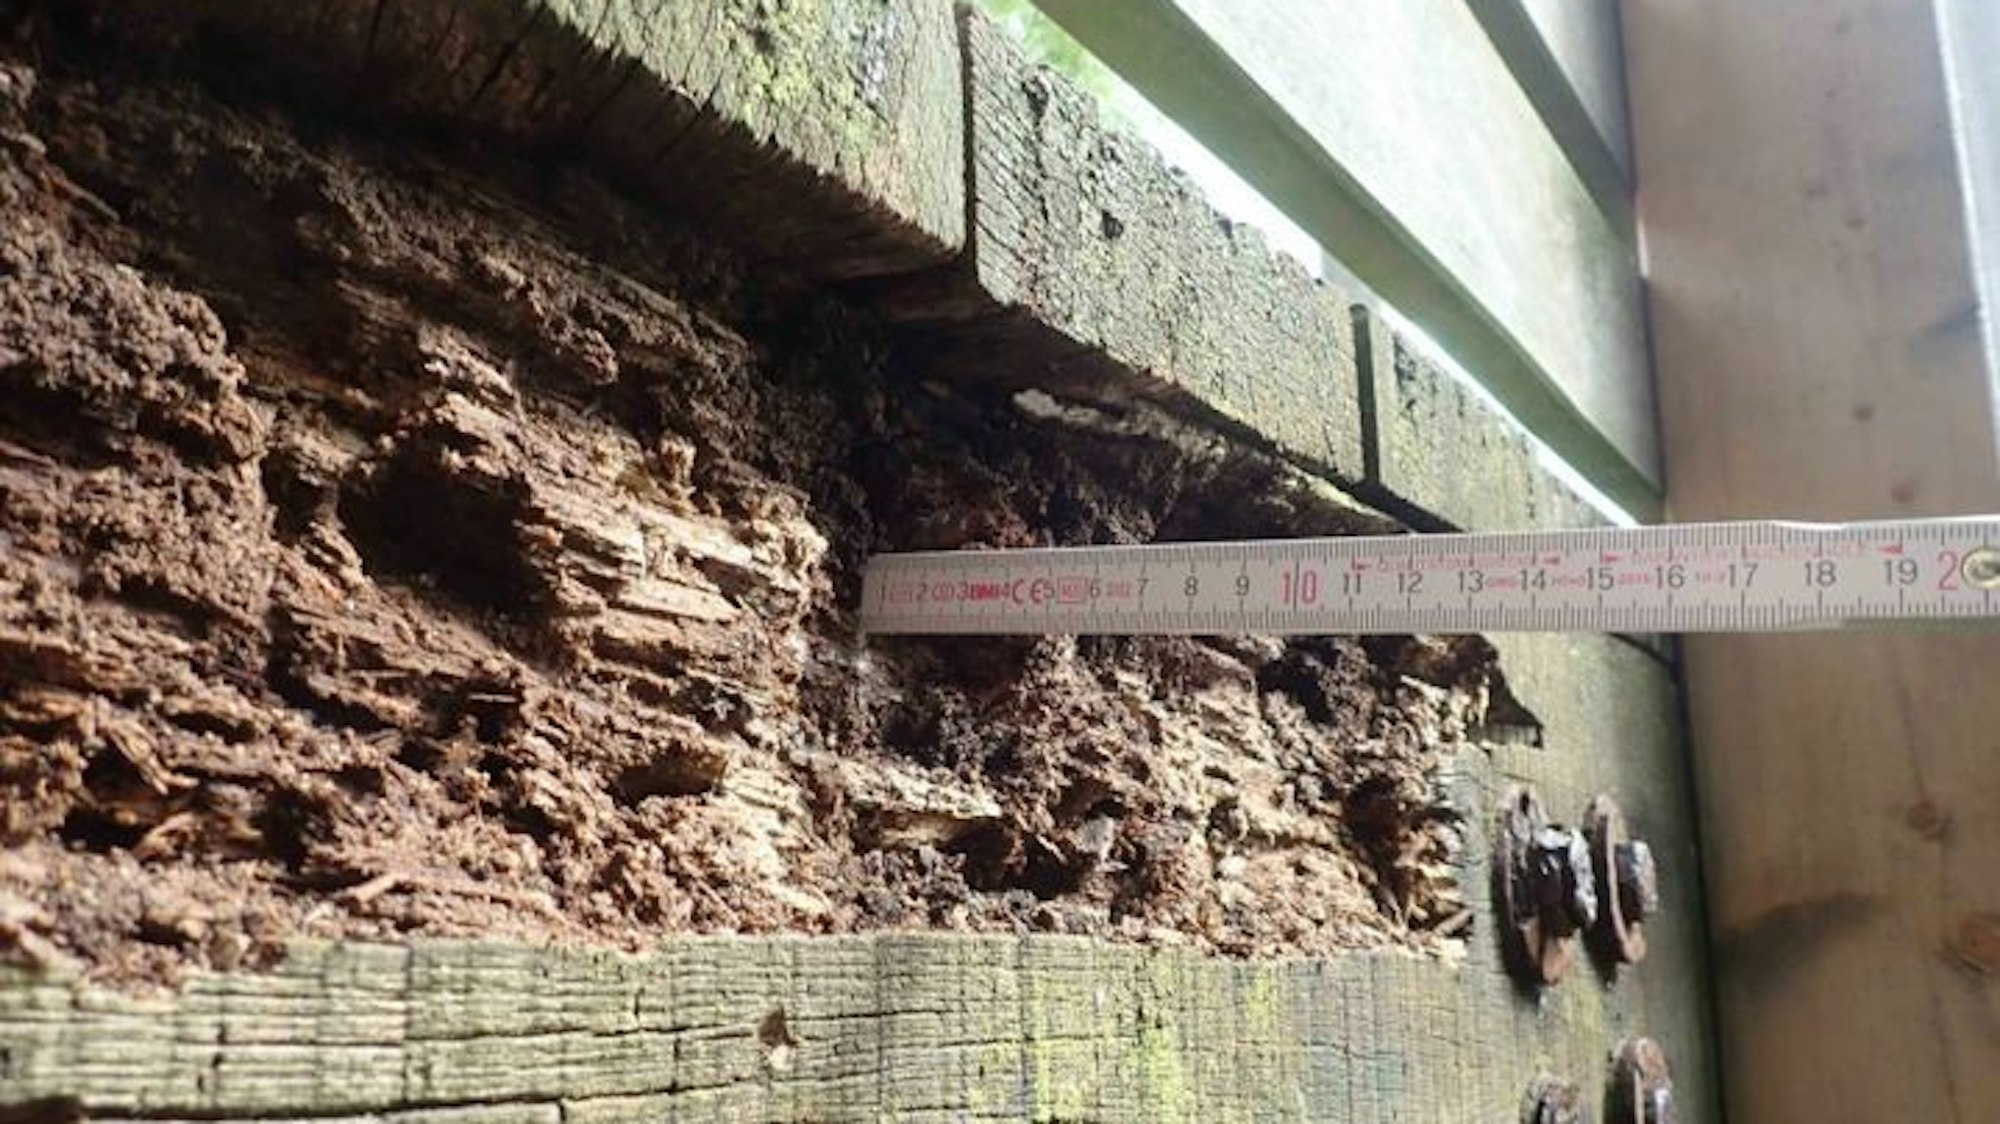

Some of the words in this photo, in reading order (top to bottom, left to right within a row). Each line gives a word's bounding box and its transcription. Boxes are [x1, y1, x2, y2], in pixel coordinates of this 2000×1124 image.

[916, 582, 928, 602] 2
[955, 580, 969, 602] 3
[1043, 580, 1056, 600] 5
[1089, 579, 1101, 600] 6
[1137, 578, 1150, 598] 7
[1184, 576, 1199, 596] 8
[1236, 574, 1251, 597] 9
[1280, 570, 1318, 604] 10
[1342, 572, 1362, 596] 11
[1398, 570, 1423, 594] 12
[1457, 569, 1485, 594] 13
[1519, 567, 1547, 592] 14
[1585, 566, 1616, 592] 15
[1654, 564, 1686, 590] 16
[1727, 562, 1760, 589] 17
[1803, 560, 1837, 588] 18
[1882, 557, 1919, 586] 19
